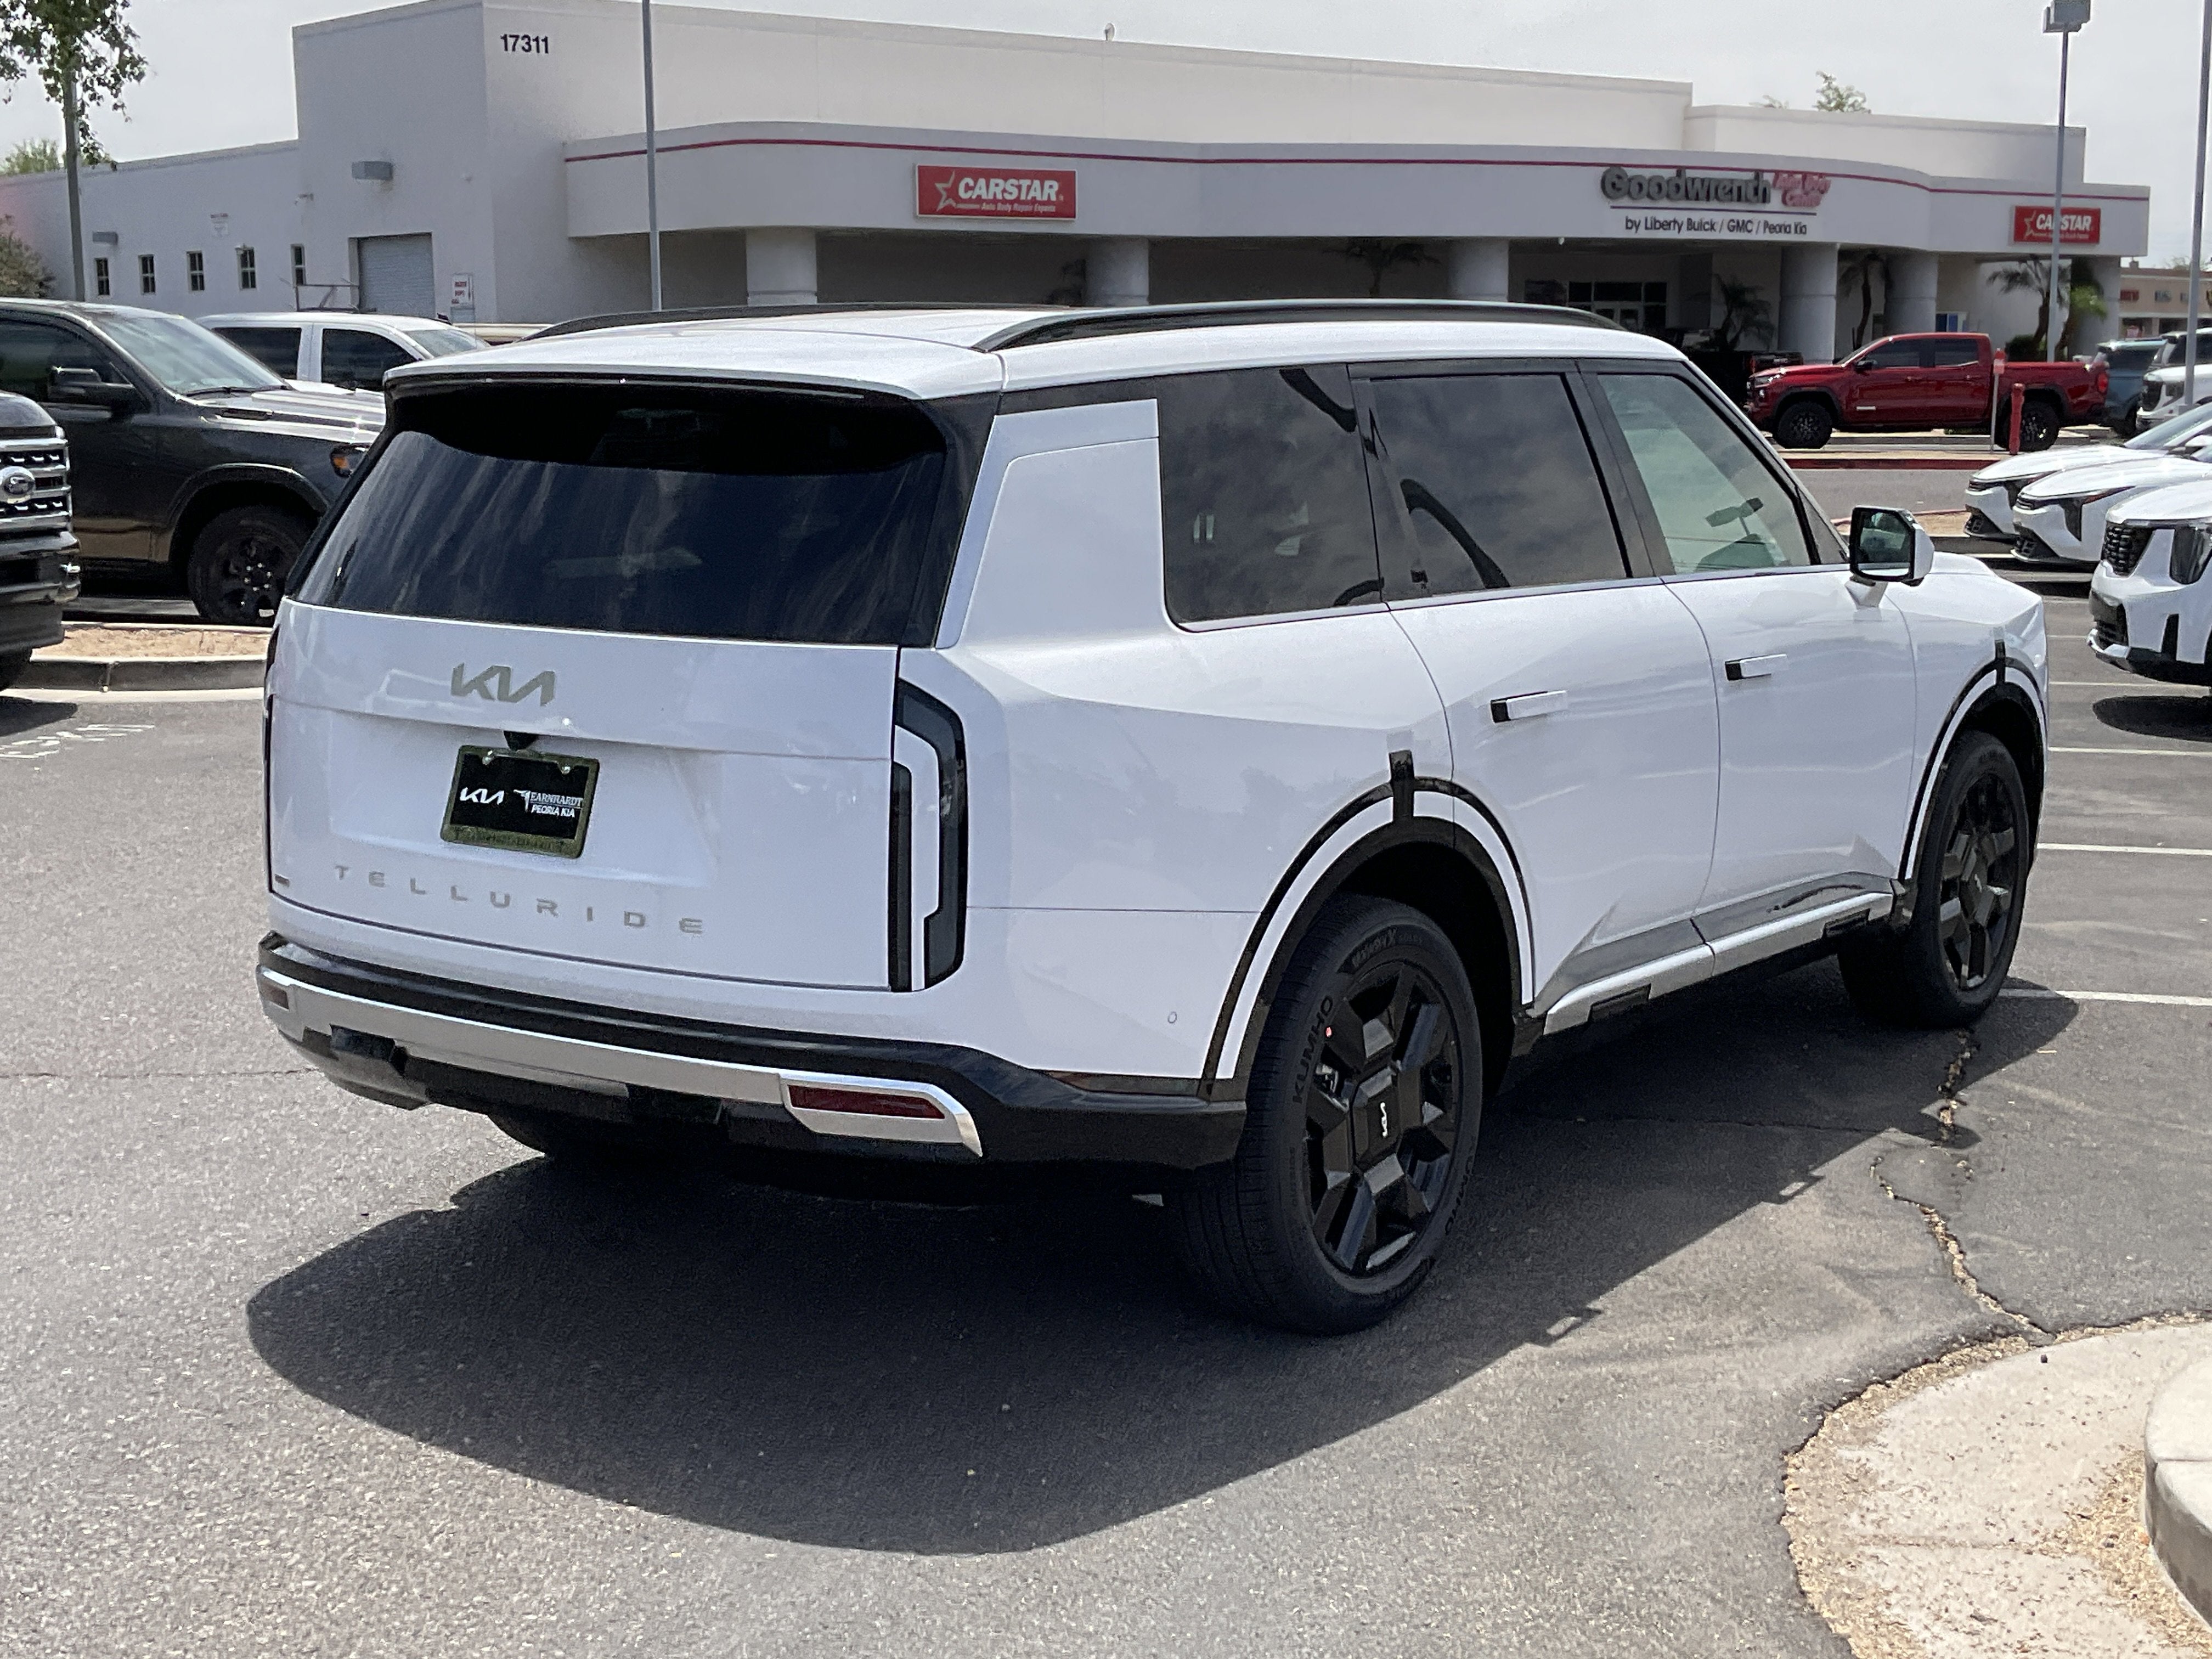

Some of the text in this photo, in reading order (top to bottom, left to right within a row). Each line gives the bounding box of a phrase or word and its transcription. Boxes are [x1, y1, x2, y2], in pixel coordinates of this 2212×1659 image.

[500, 34, 549, 54] 17311
[958, 177, 1059, 201] CARSTAR
[1600, 166, 1771, 204] Goodwrench
[1625, 216, 1641, 234] by
[1645, 216, 1684, 234] Liberty
[1686, 217, 1717, 232] Buick
[1728, 219, 1753, 233] GMC
[1763, 220, 1792, 235] Peoria
[1794, 222, 1807, 235] Kia
[2036, 213, 2092, 231] CASTAR
[530, 792, 583, 806] EARNHARDT
[531, 804, 575, 817] PEORIA KIA
[335, 865, 703, 935] TELLURIDE
[1293, 996, 1333, 1104] KUMHO
